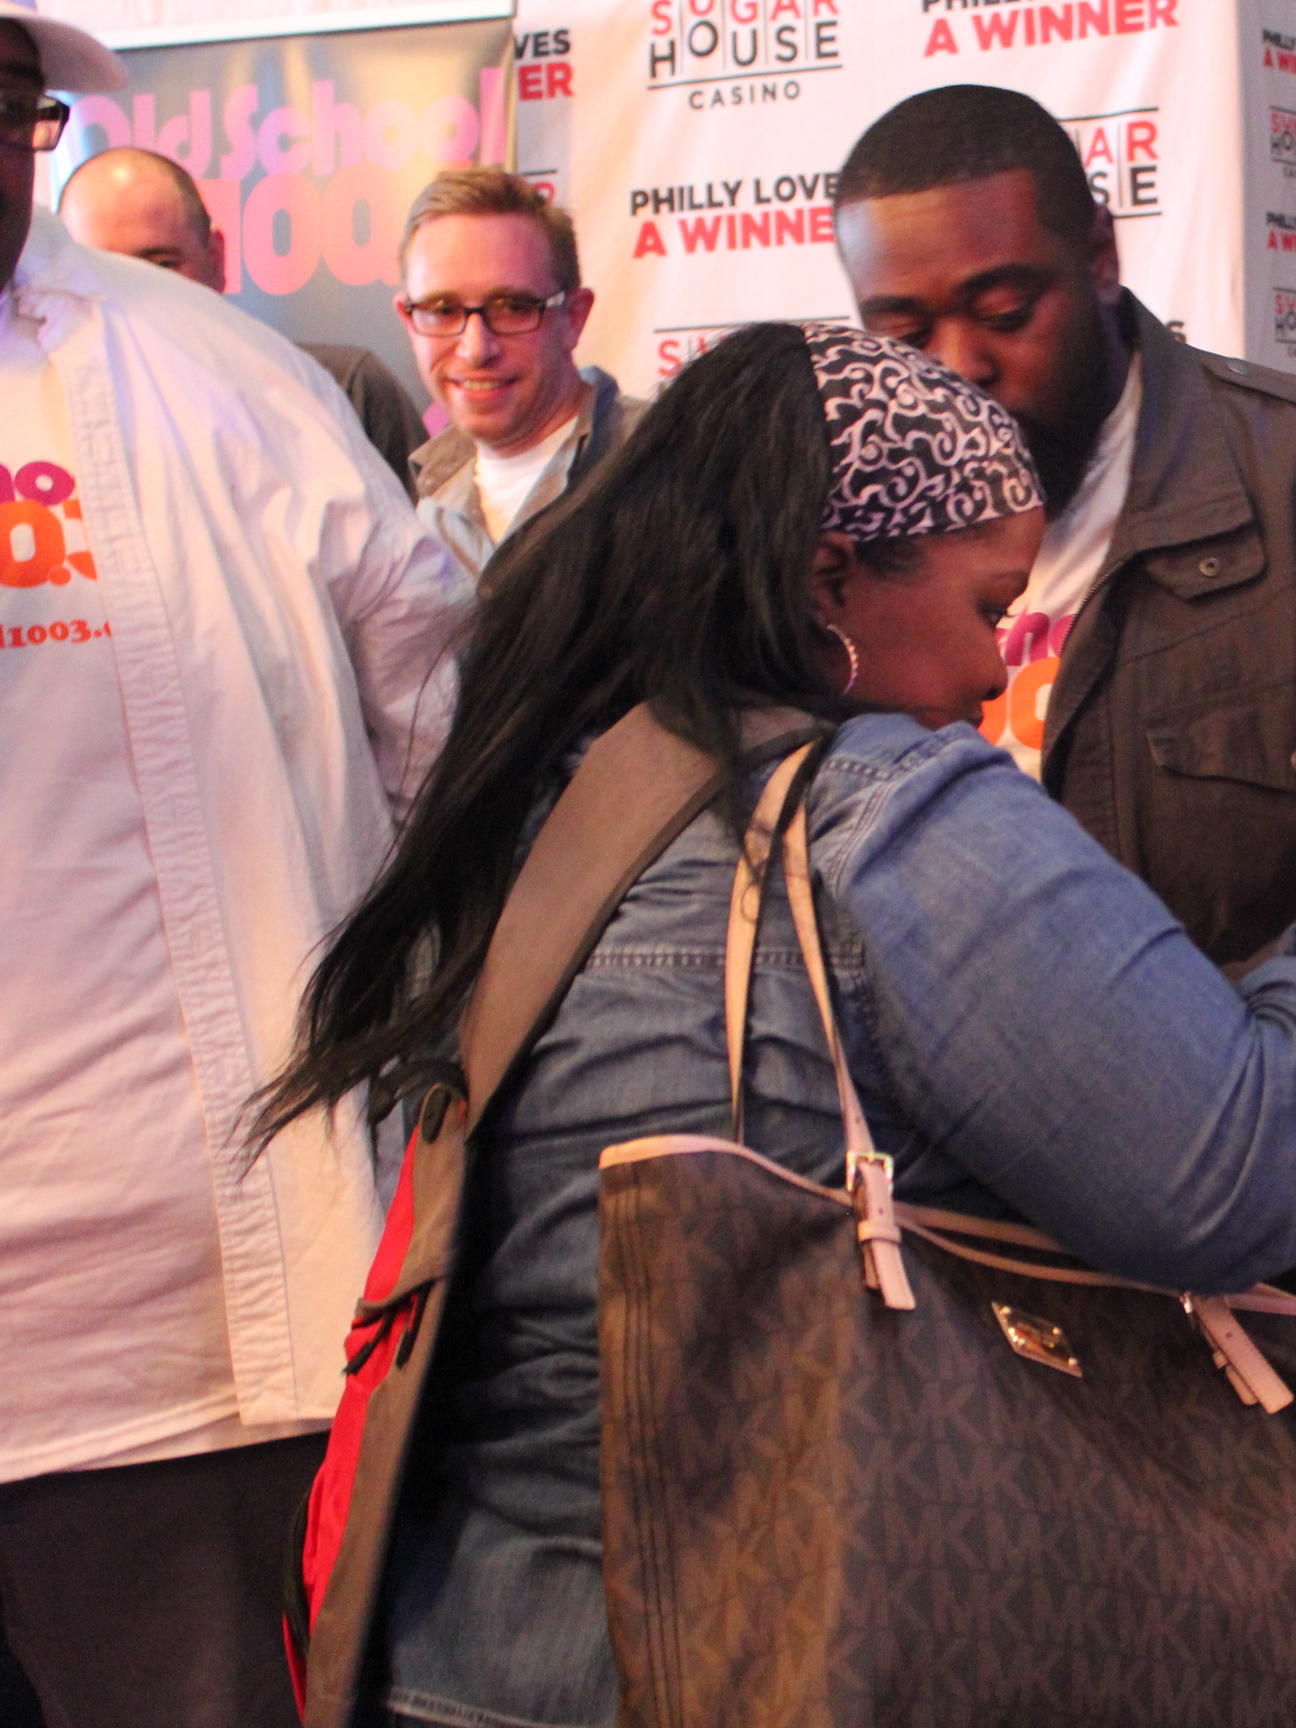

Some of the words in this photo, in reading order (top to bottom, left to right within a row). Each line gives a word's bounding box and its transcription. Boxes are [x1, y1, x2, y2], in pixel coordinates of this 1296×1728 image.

[514, 30, 571, 58] VES
[650, 20, 838, 78] HOUSE
[924, 18, 959, 58] A
[972, 0, 1179, 52] WINNER
[518, 62, 574, 101] ER
[688, 80, 802, 110] CASINO
[1085, 121, 1159, 168] AR
[630, 180, 742, 216] PHILLY
[755, 173, 841, 206] LOVE
[633, 222, 667, 259] A
[679, 206, 836, 254] WINNE
